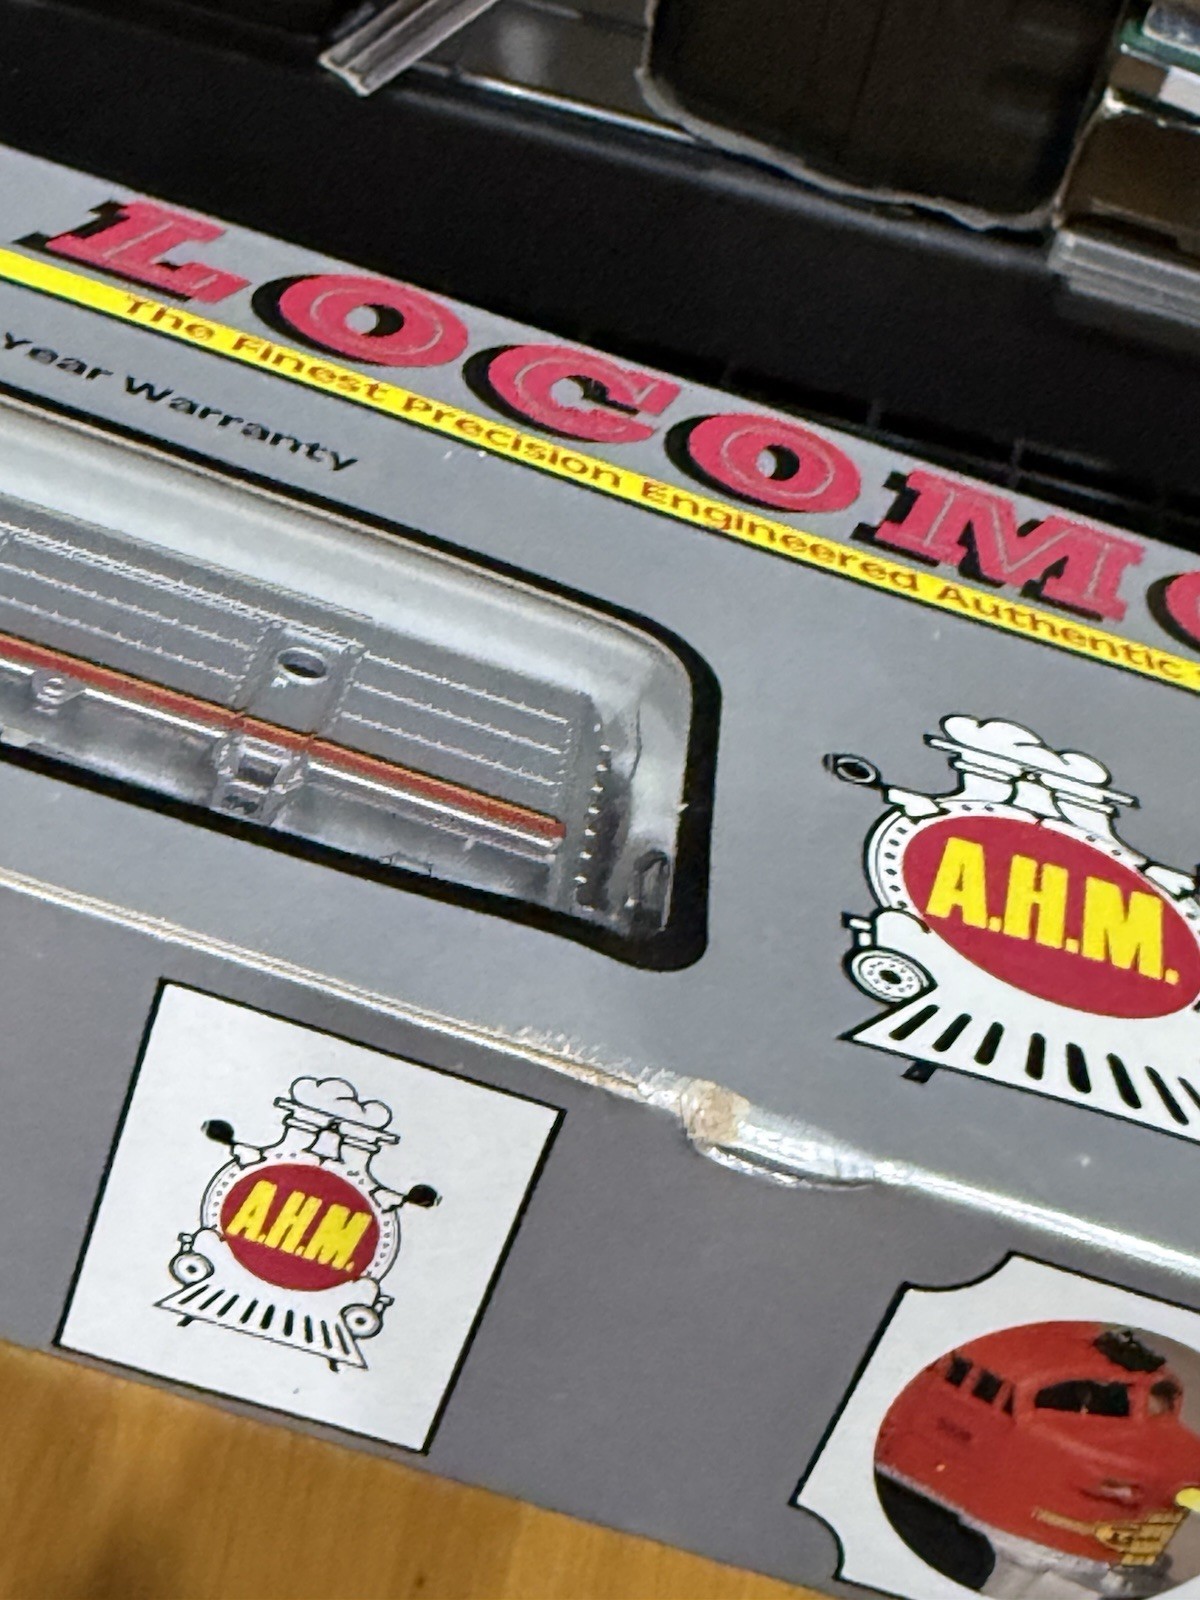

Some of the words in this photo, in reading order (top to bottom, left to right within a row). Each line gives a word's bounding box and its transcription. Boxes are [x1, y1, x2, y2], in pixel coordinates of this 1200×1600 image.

[4, 331, 114, 380] Year
[125, 374, 359, 471] Warranty
[13, 197, 1200, 650] LOCOM
[126, 297, 215, 340] The
[231, 333, 388, 401] Finest
[402, 395, 622, 489] Precision
[640, 481, 919, 594] Engineered
[937, 584, 1183, 680] Authentic
[926, 836, 1180, 985] A.H.M.
[227, 1180, 372, 1272] A.H.M.
